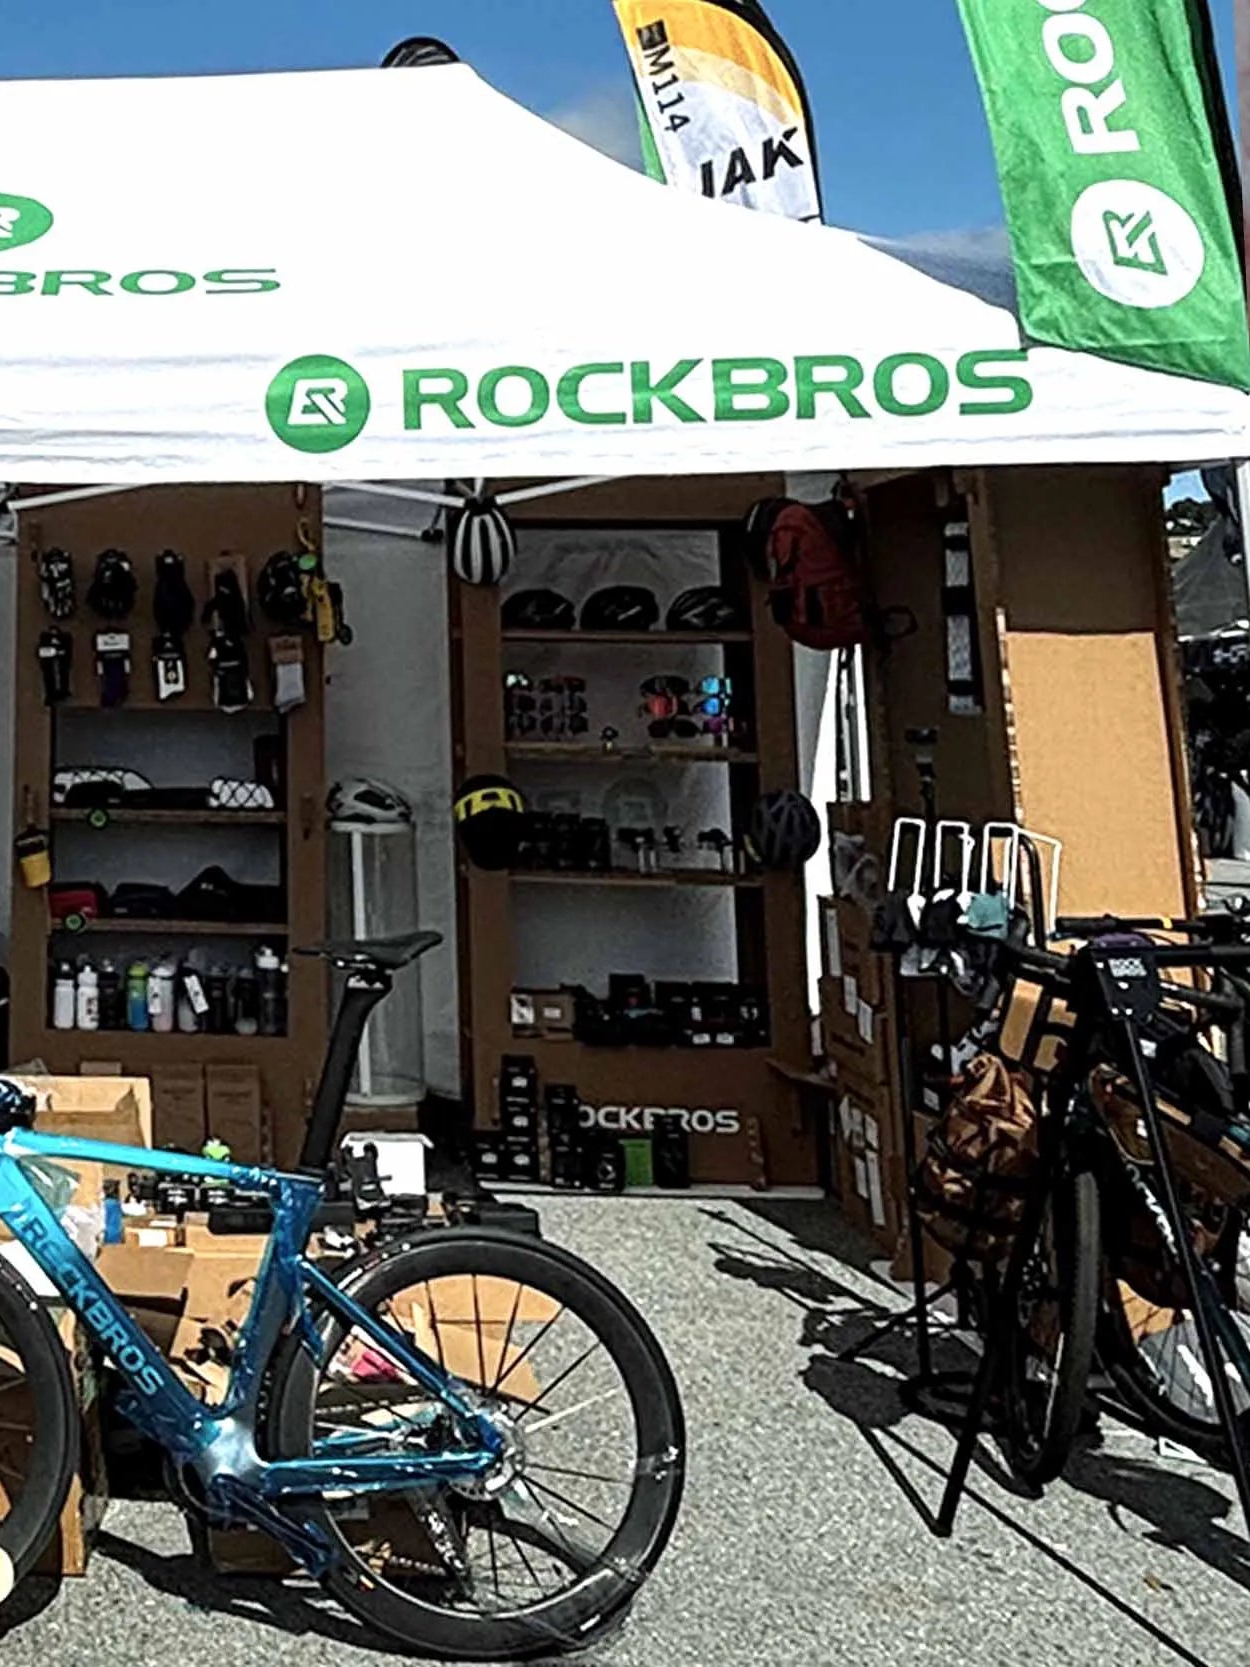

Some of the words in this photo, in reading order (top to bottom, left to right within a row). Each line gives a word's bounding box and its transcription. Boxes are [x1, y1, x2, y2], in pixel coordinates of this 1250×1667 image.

[1037, 0, 1141, 155] RO
[402, 349, 1033, 431] ROCKBROS
[577, 1105, 741, 1134] OCKROS
